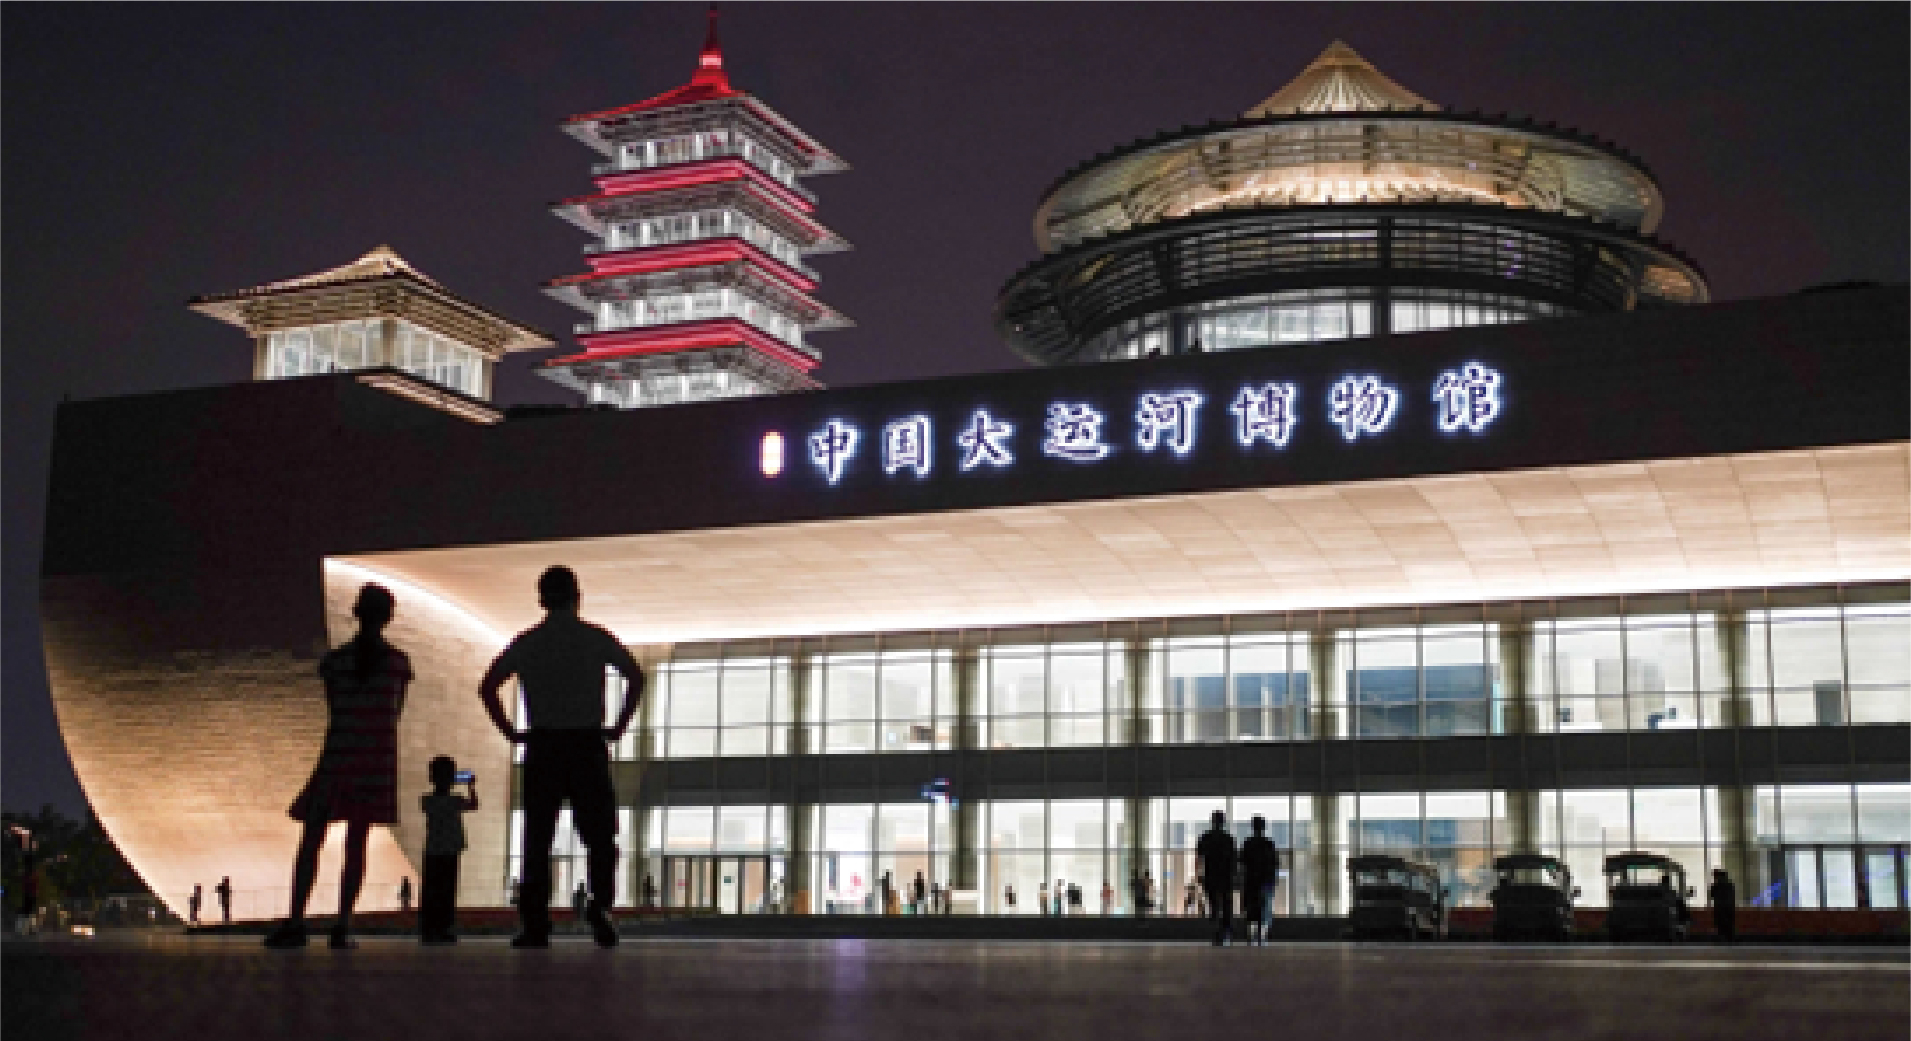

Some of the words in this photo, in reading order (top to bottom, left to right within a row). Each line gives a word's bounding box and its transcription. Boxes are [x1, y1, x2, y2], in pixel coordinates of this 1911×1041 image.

[807, 361, 1505, 486] 中国大运河博物馆
